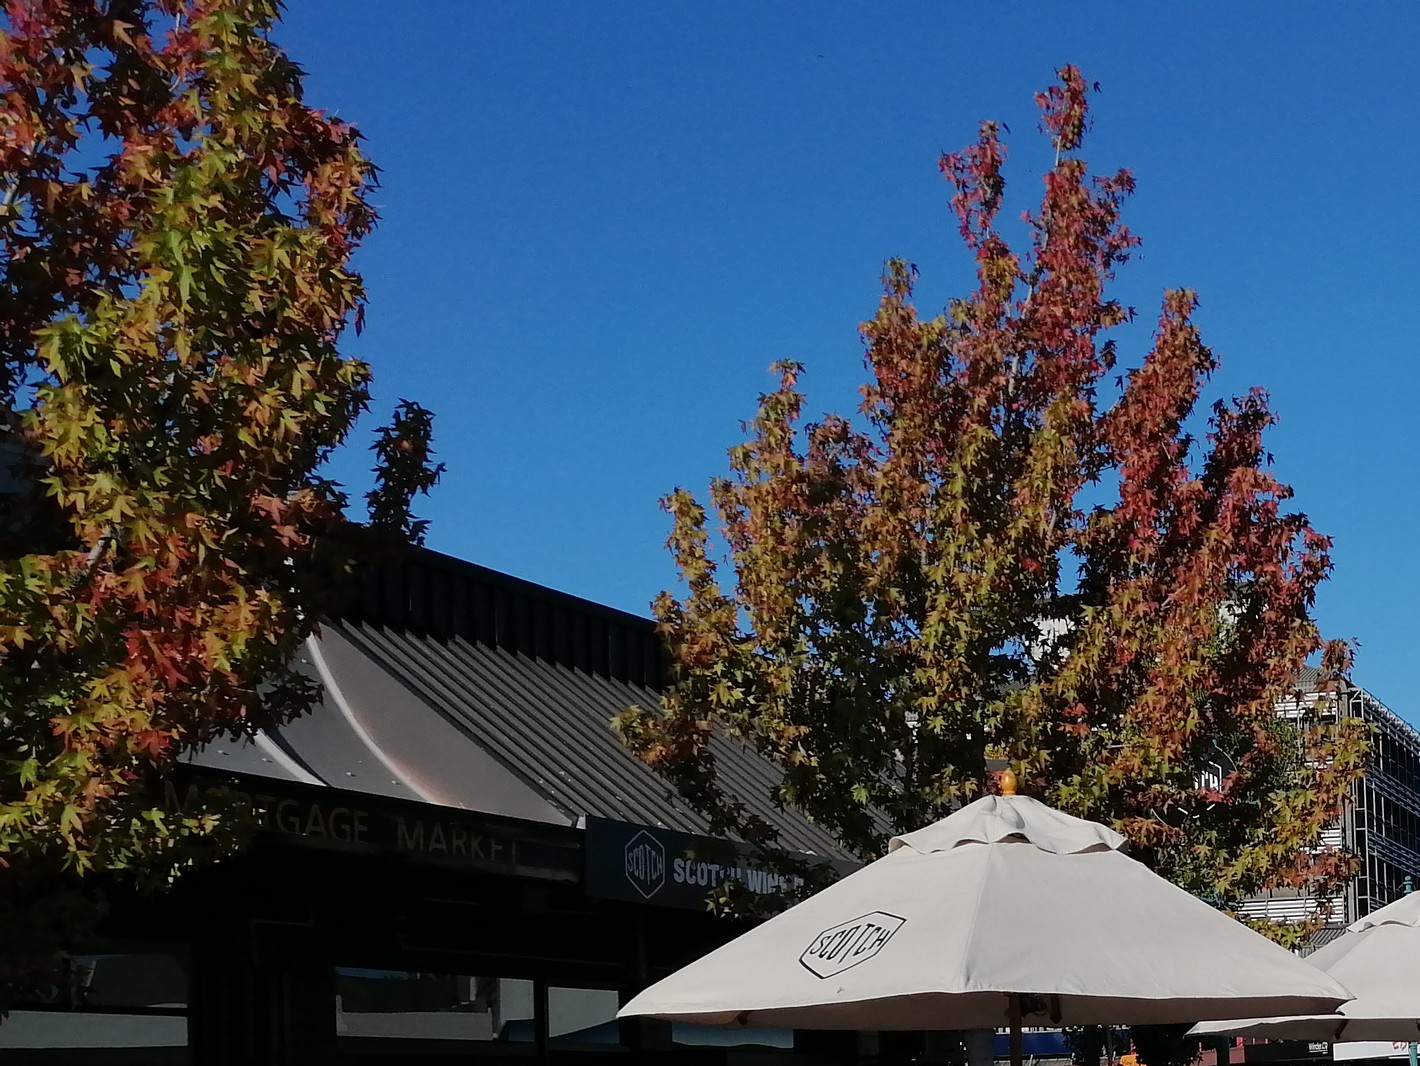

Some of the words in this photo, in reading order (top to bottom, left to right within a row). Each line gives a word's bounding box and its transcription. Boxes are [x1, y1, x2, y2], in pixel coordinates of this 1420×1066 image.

[163, 780, 369, 844] MTGAGE
[627, 843, 663, 886] SCOTCH
[809, 922, 891, 965] SCOTCH
